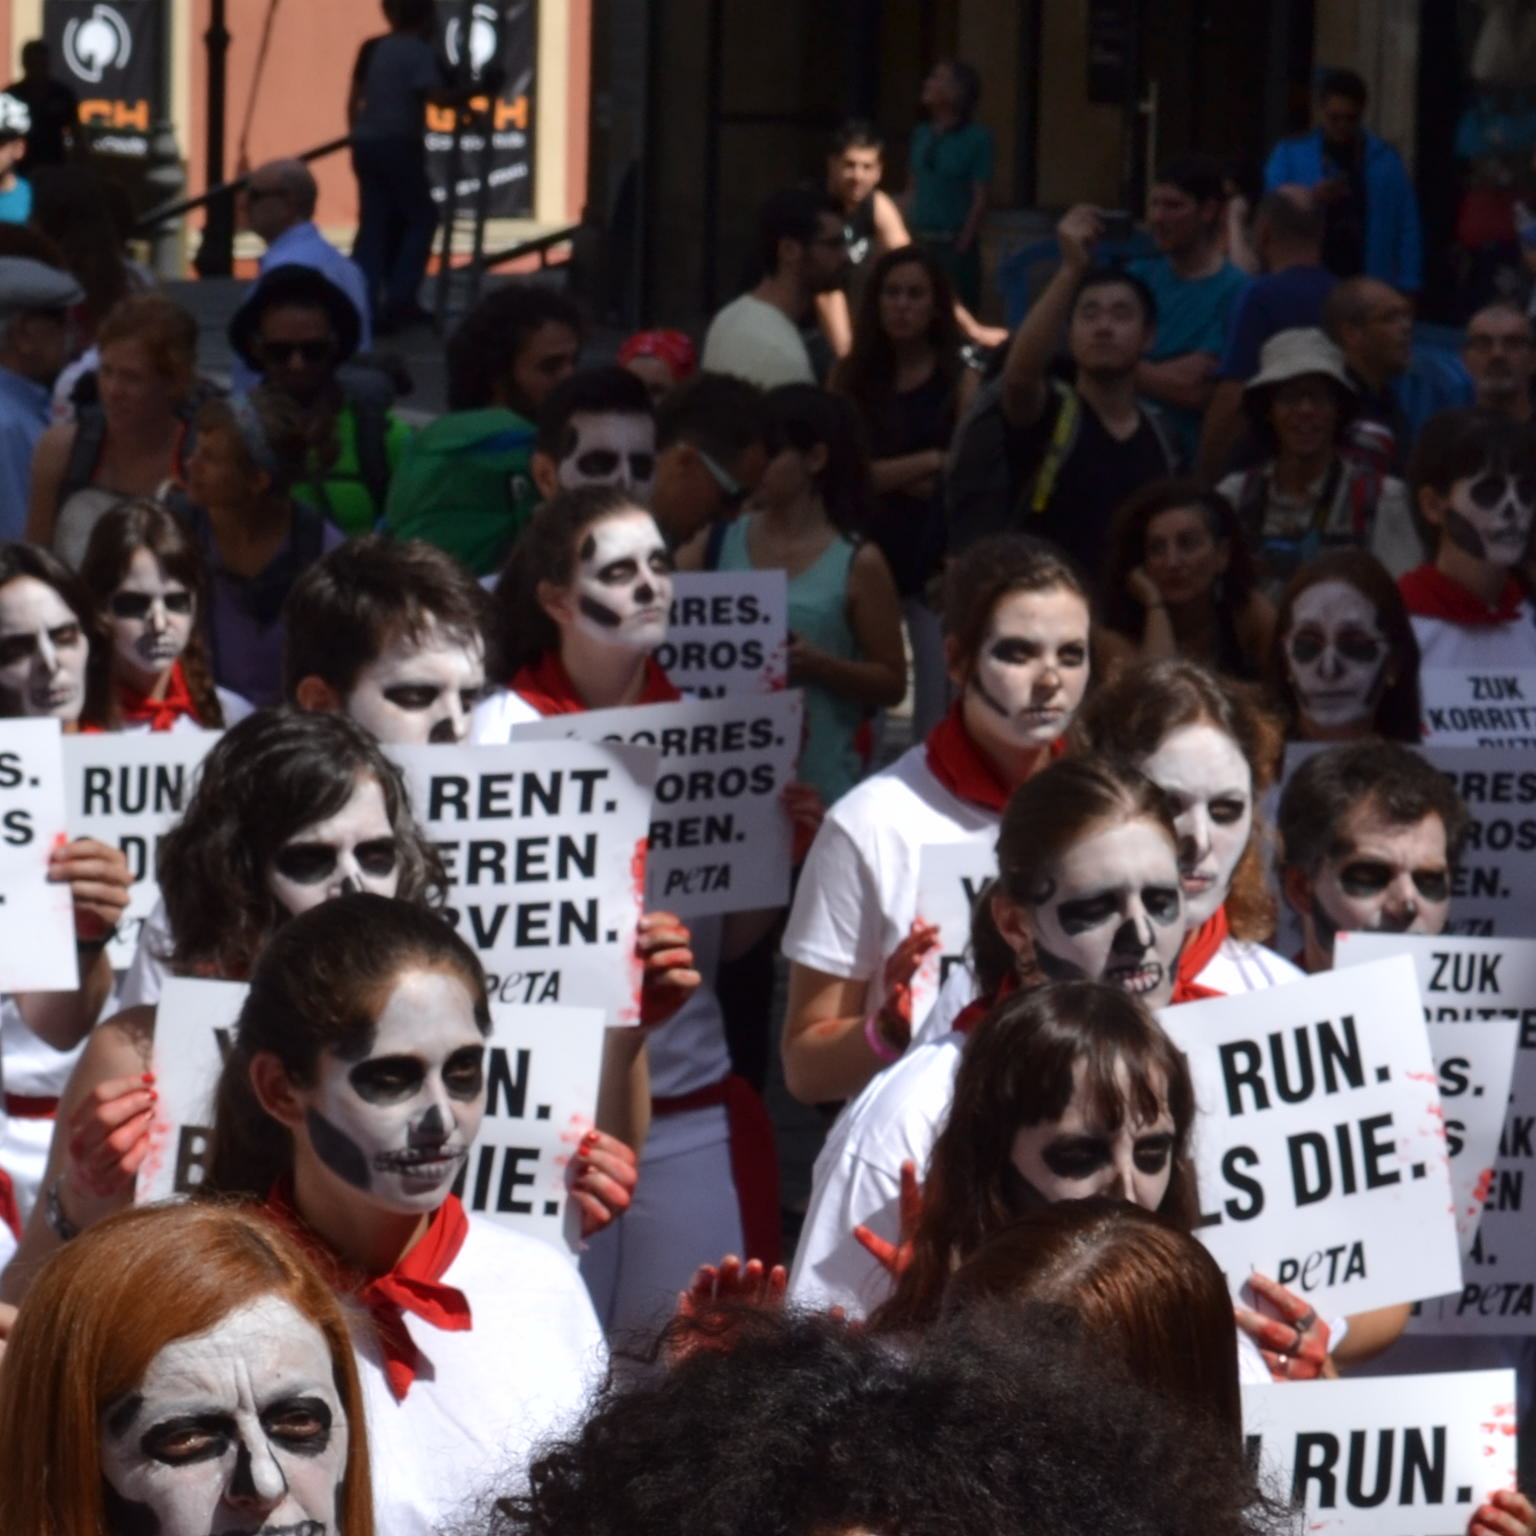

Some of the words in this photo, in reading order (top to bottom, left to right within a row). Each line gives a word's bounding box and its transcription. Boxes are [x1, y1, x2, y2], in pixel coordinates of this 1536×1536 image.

[656, 640, 765, 671] OROS
[1468, 676, 1524, 701] ZUK
[428, 768, 618, 820] RENT.
[654, 763, 776, 803] OROS
[1427, 952, 1503, 994] ZUK
[1218, 1014, 1392, 1118] RUN.
[1286, 1112, 1427, 1209] DIE.
[1292, 1424, 1474, 1511] RUN.
